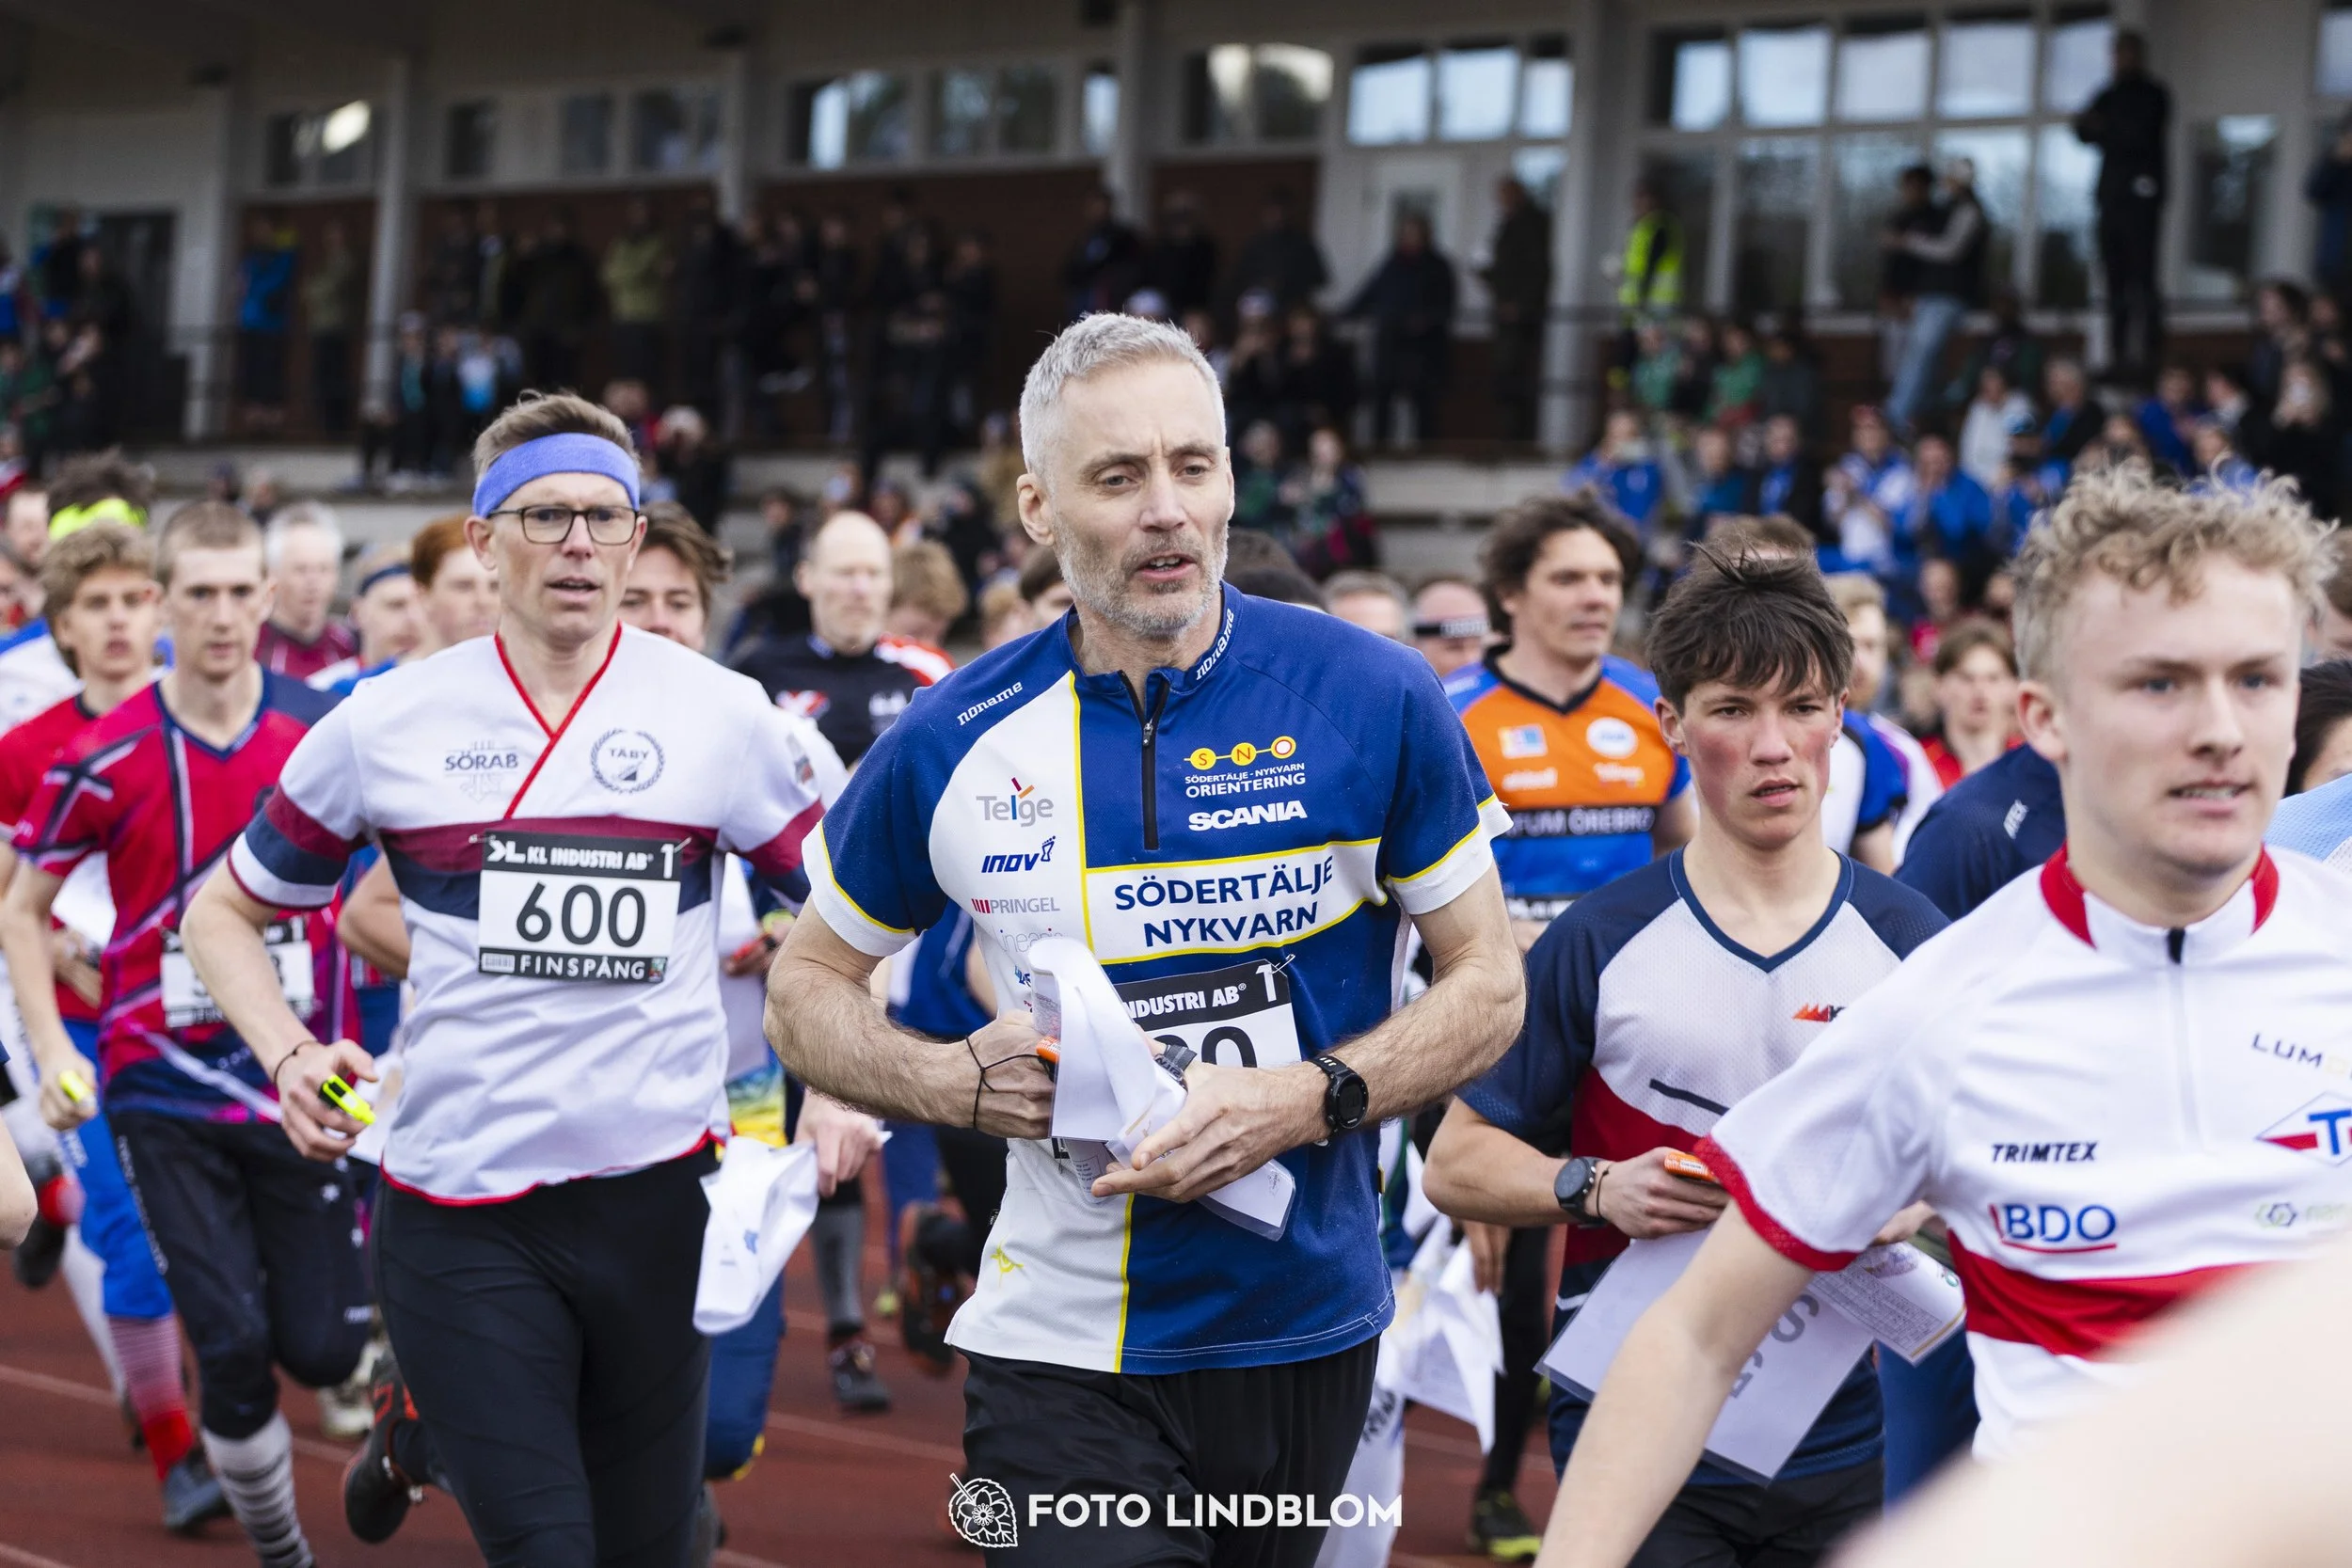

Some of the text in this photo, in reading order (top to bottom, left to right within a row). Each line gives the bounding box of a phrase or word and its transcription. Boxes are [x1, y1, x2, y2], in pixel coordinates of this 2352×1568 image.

[1196, 608, 1234, 681] noname
[957, 681, 1024, 726] noname
[444, 751, 518, 771] SÖRAB
[1185, 772, 1306, 798] ORIENTERING
[976, 794, 1054, 828] Telge
[1188, 800, 1308, 832] SCANIA
[528, 846, 548, 864] KL
[550, 847, 623, 869] INDUSTRI
[660, 843, 675, 879] 1
[1114, 855, 1333, 911] SÖDERTÄLJE
[516, 880, 646, 948] 600
[991, 896, 1061, 914] PRINGEL
[1143, 901, 1318, 947] NYKVARN
[519, 954, 645, 980] FINSPÅNG
[1256, 963, 1278, 1003] 1
[1123, 990, 1206, 1019] NDUSTRI
[1991, 1141, 2100, 1164] TRIMTEX
[2001, 1203, 2117, 1243] BDO
